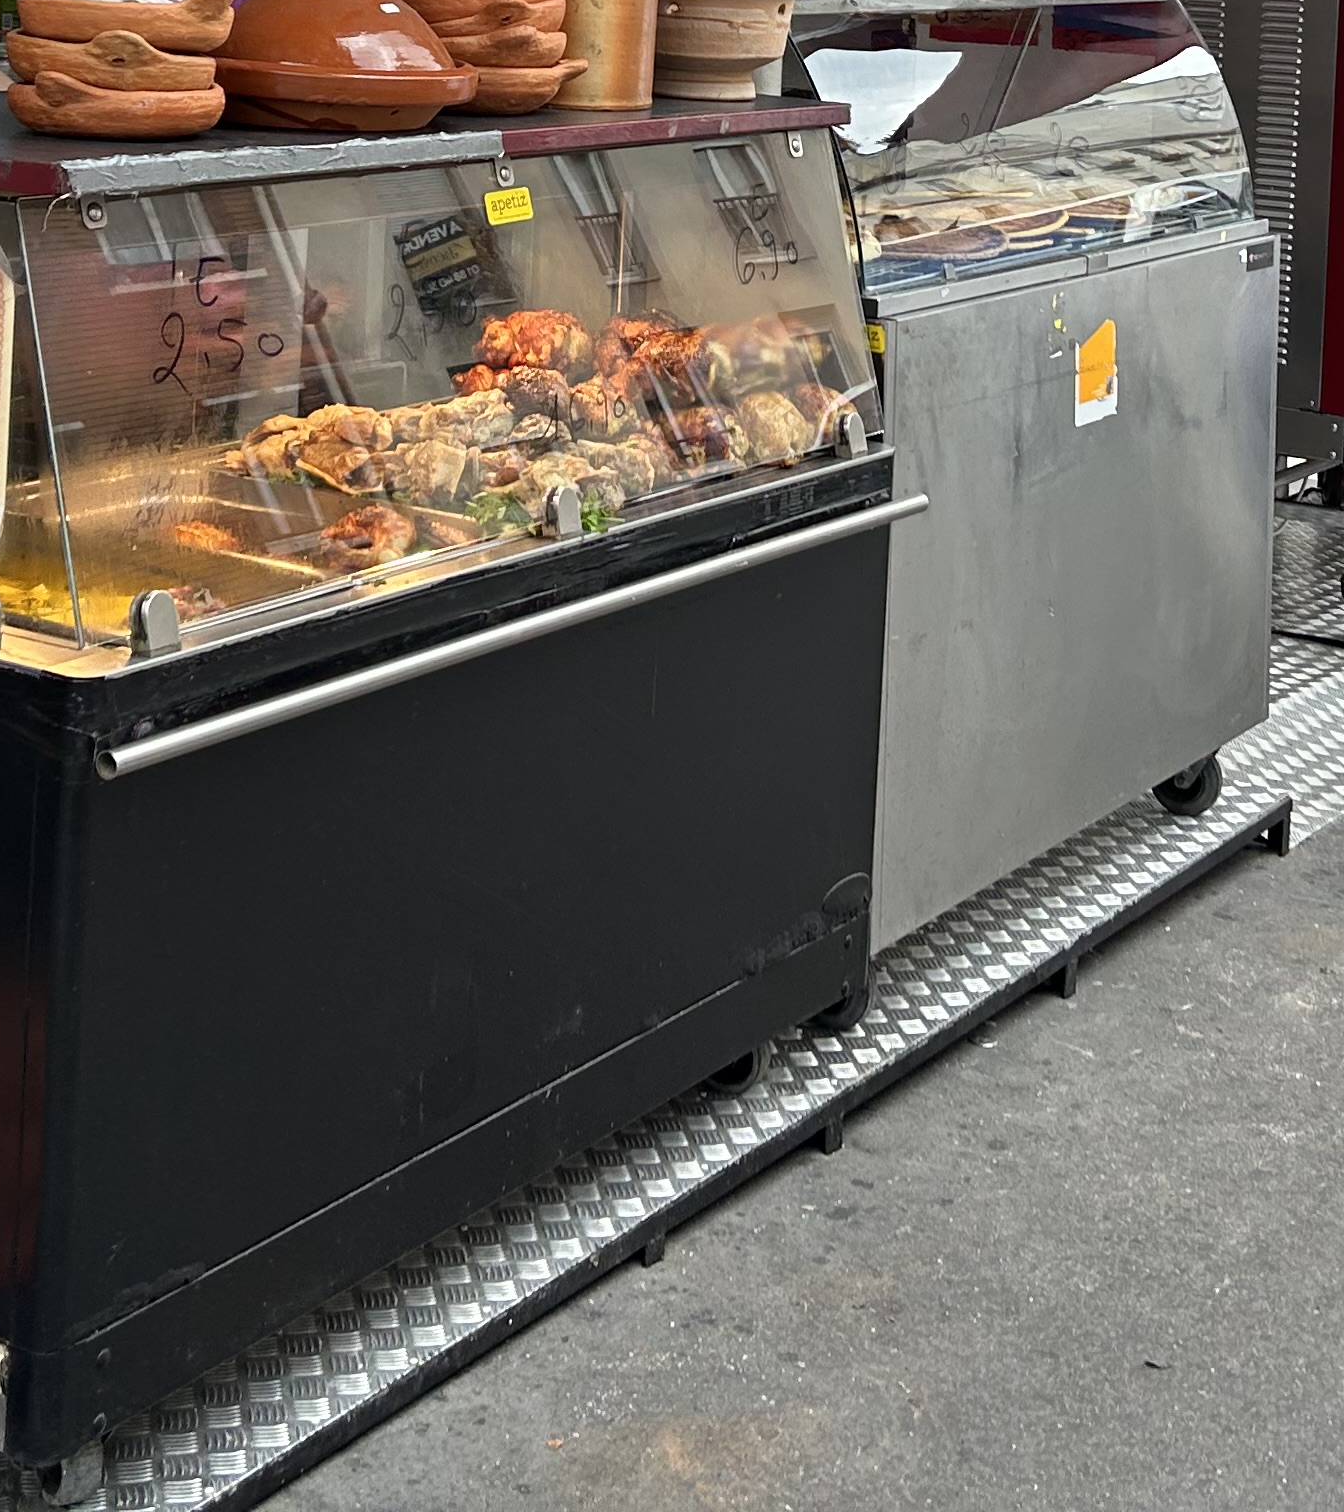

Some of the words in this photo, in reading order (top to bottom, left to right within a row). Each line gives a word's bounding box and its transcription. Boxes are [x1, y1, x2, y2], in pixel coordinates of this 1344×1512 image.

[491, 192, 529, 216] apetiz
[735, 226, 798, 285] 6,90
[153, 312, 285, 394] 2,50
